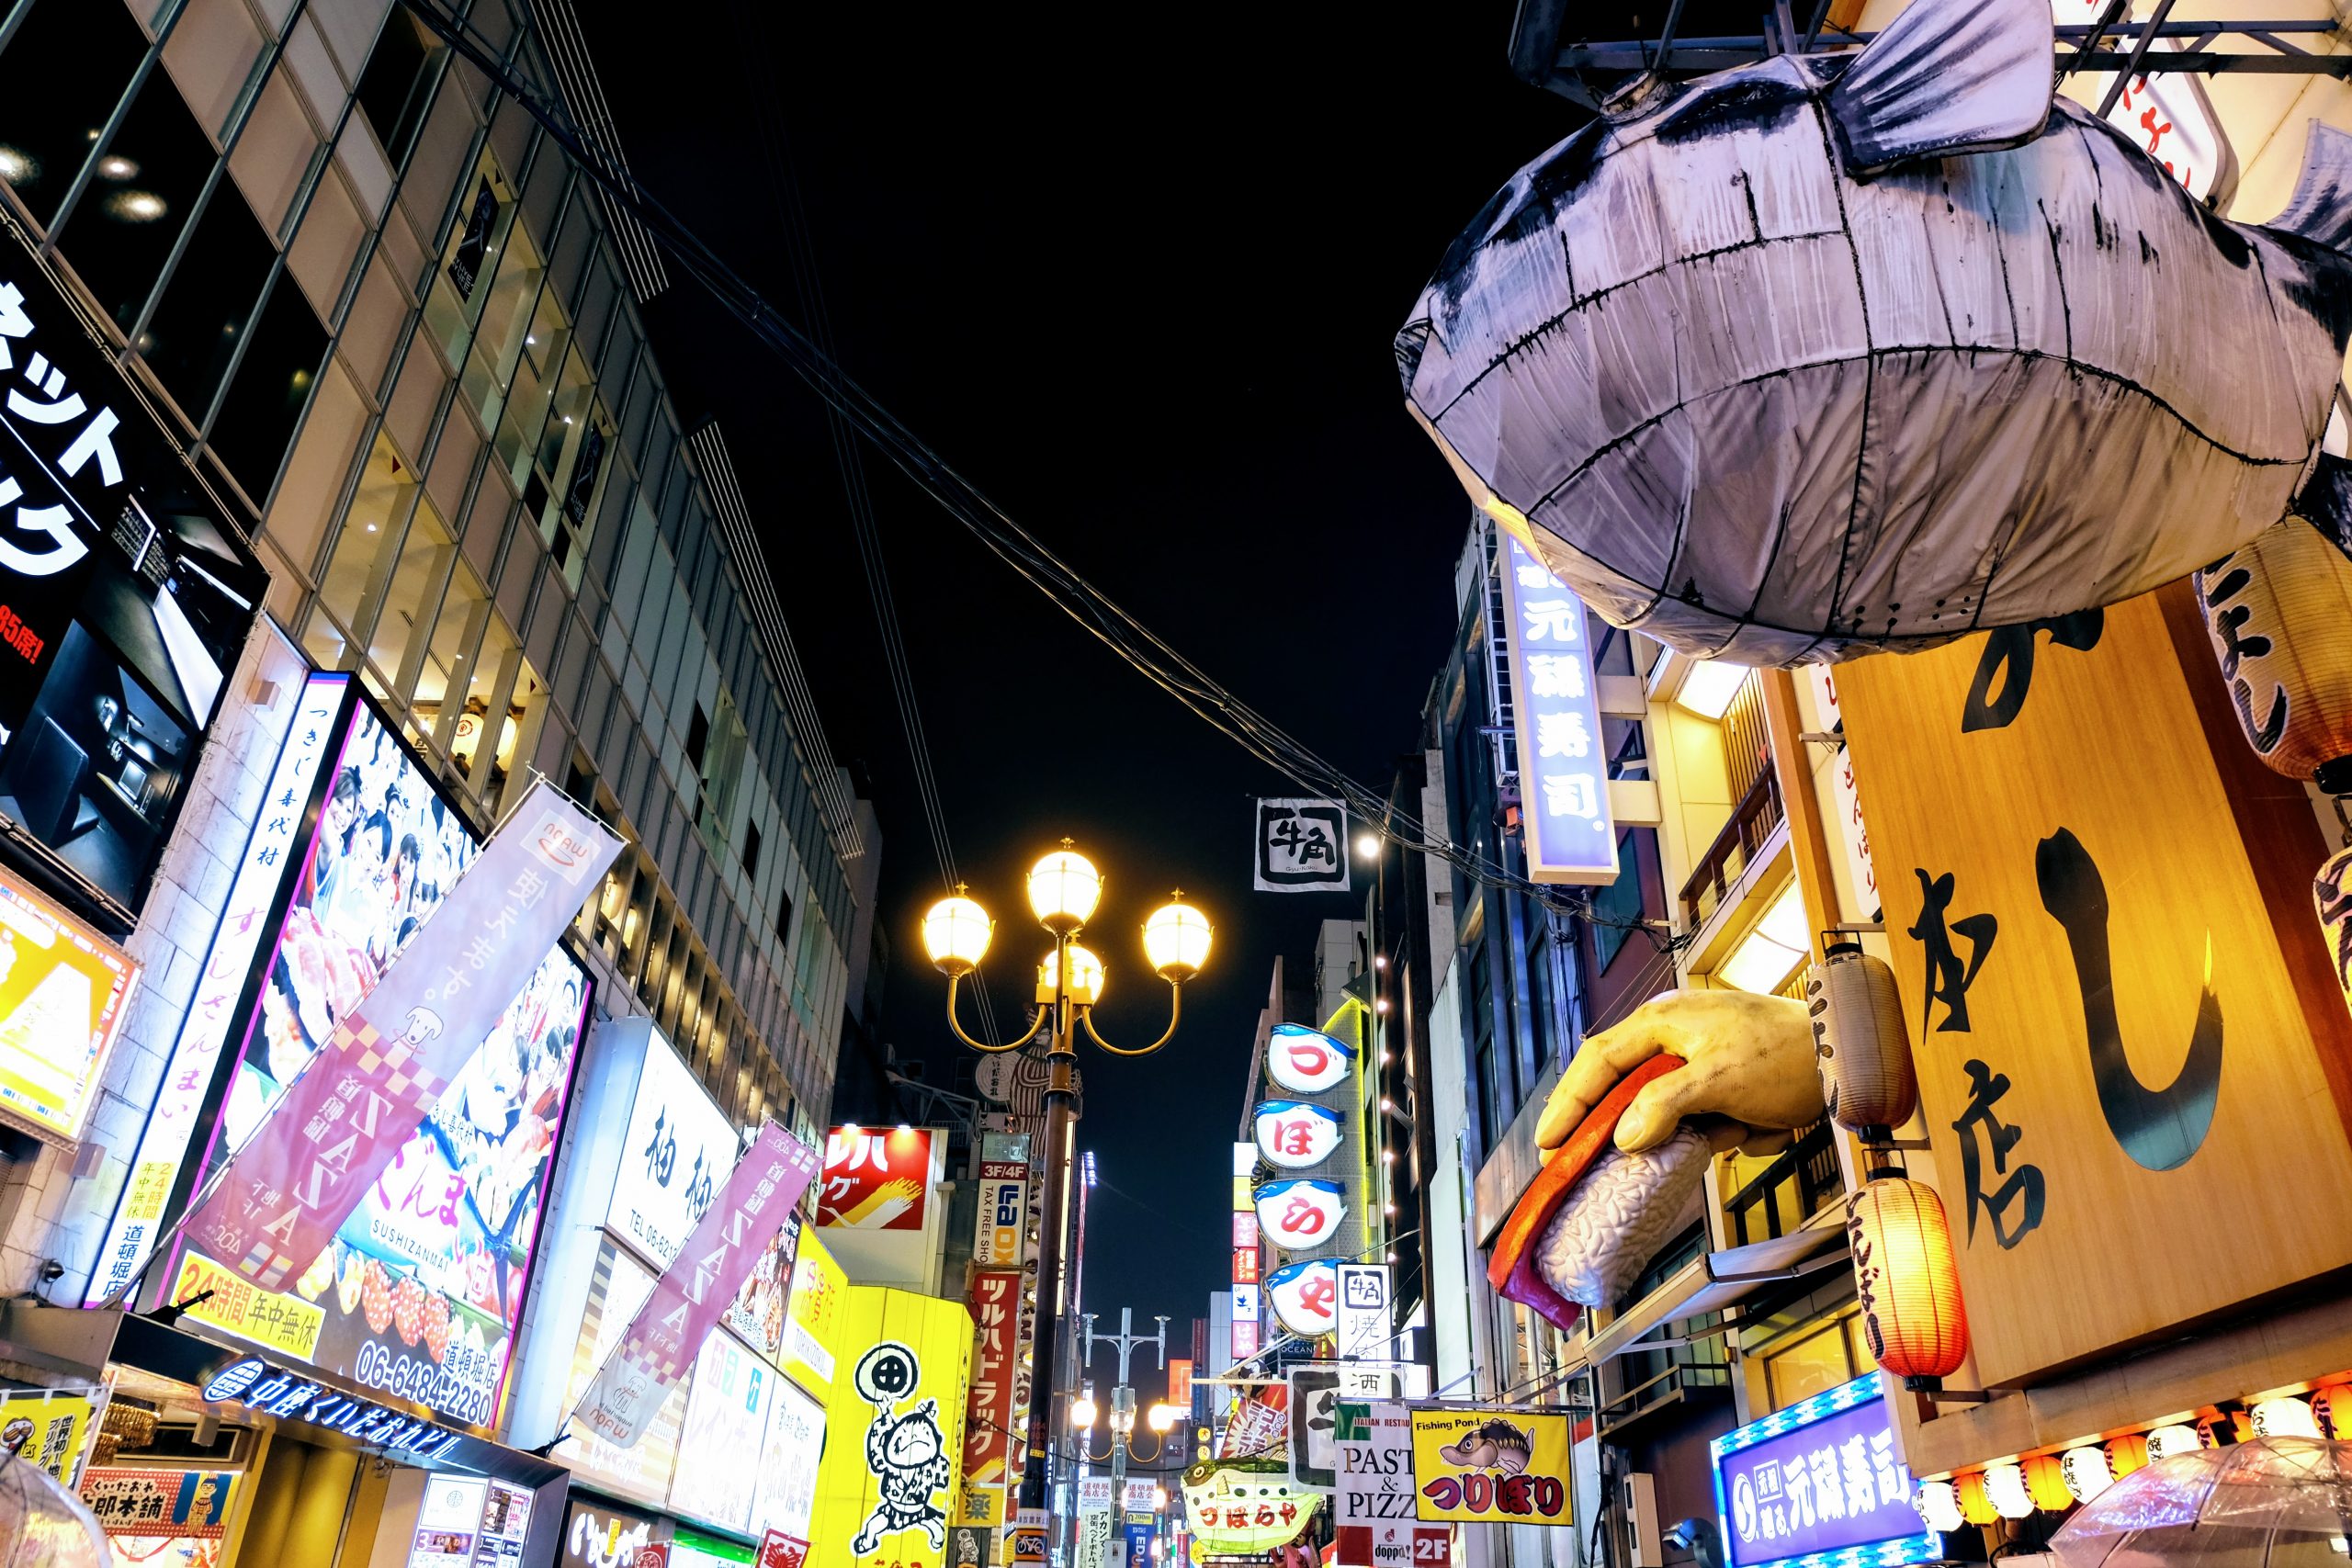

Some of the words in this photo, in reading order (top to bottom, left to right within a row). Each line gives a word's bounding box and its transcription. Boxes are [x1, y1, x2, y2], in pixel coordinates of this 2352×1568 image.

[256, 709, 328, 867] つきじ喜代村
[1270, 820, 1335, 865] 牛角
[984, 1164, 1025, 1178] 3F/4F
[141, 1162, 172, 1220] 24時間
[983, 1185, 994, 1206] TAX
[630, 1209, 643, 1238] TEL
[981, 1208, 993, 1237] FREE
[371, 1219, 449, 1273] SUSHIZANMAI
[248, 1294, 316, 1350] 年中無休
[444, 1339, 499, 1389] 道頓堀店
[357, 1344, 491, 1426] 06-6484-2280
[1354, 1417, 1380, 1427] ITALIAN
[1416, 1420, 1453, 1431] Fishing
[1455, 1418, 1480, 1428] Pond
[94, 1481, 154, 1493] くいだおれ
[1381, 1476, 1399, 1493] &
[1422, 1474, 1565, 1517] つりぼり
[965, 1493, 991, 1520] 薬
[1416, 1539, 1447, 1561] 2F
